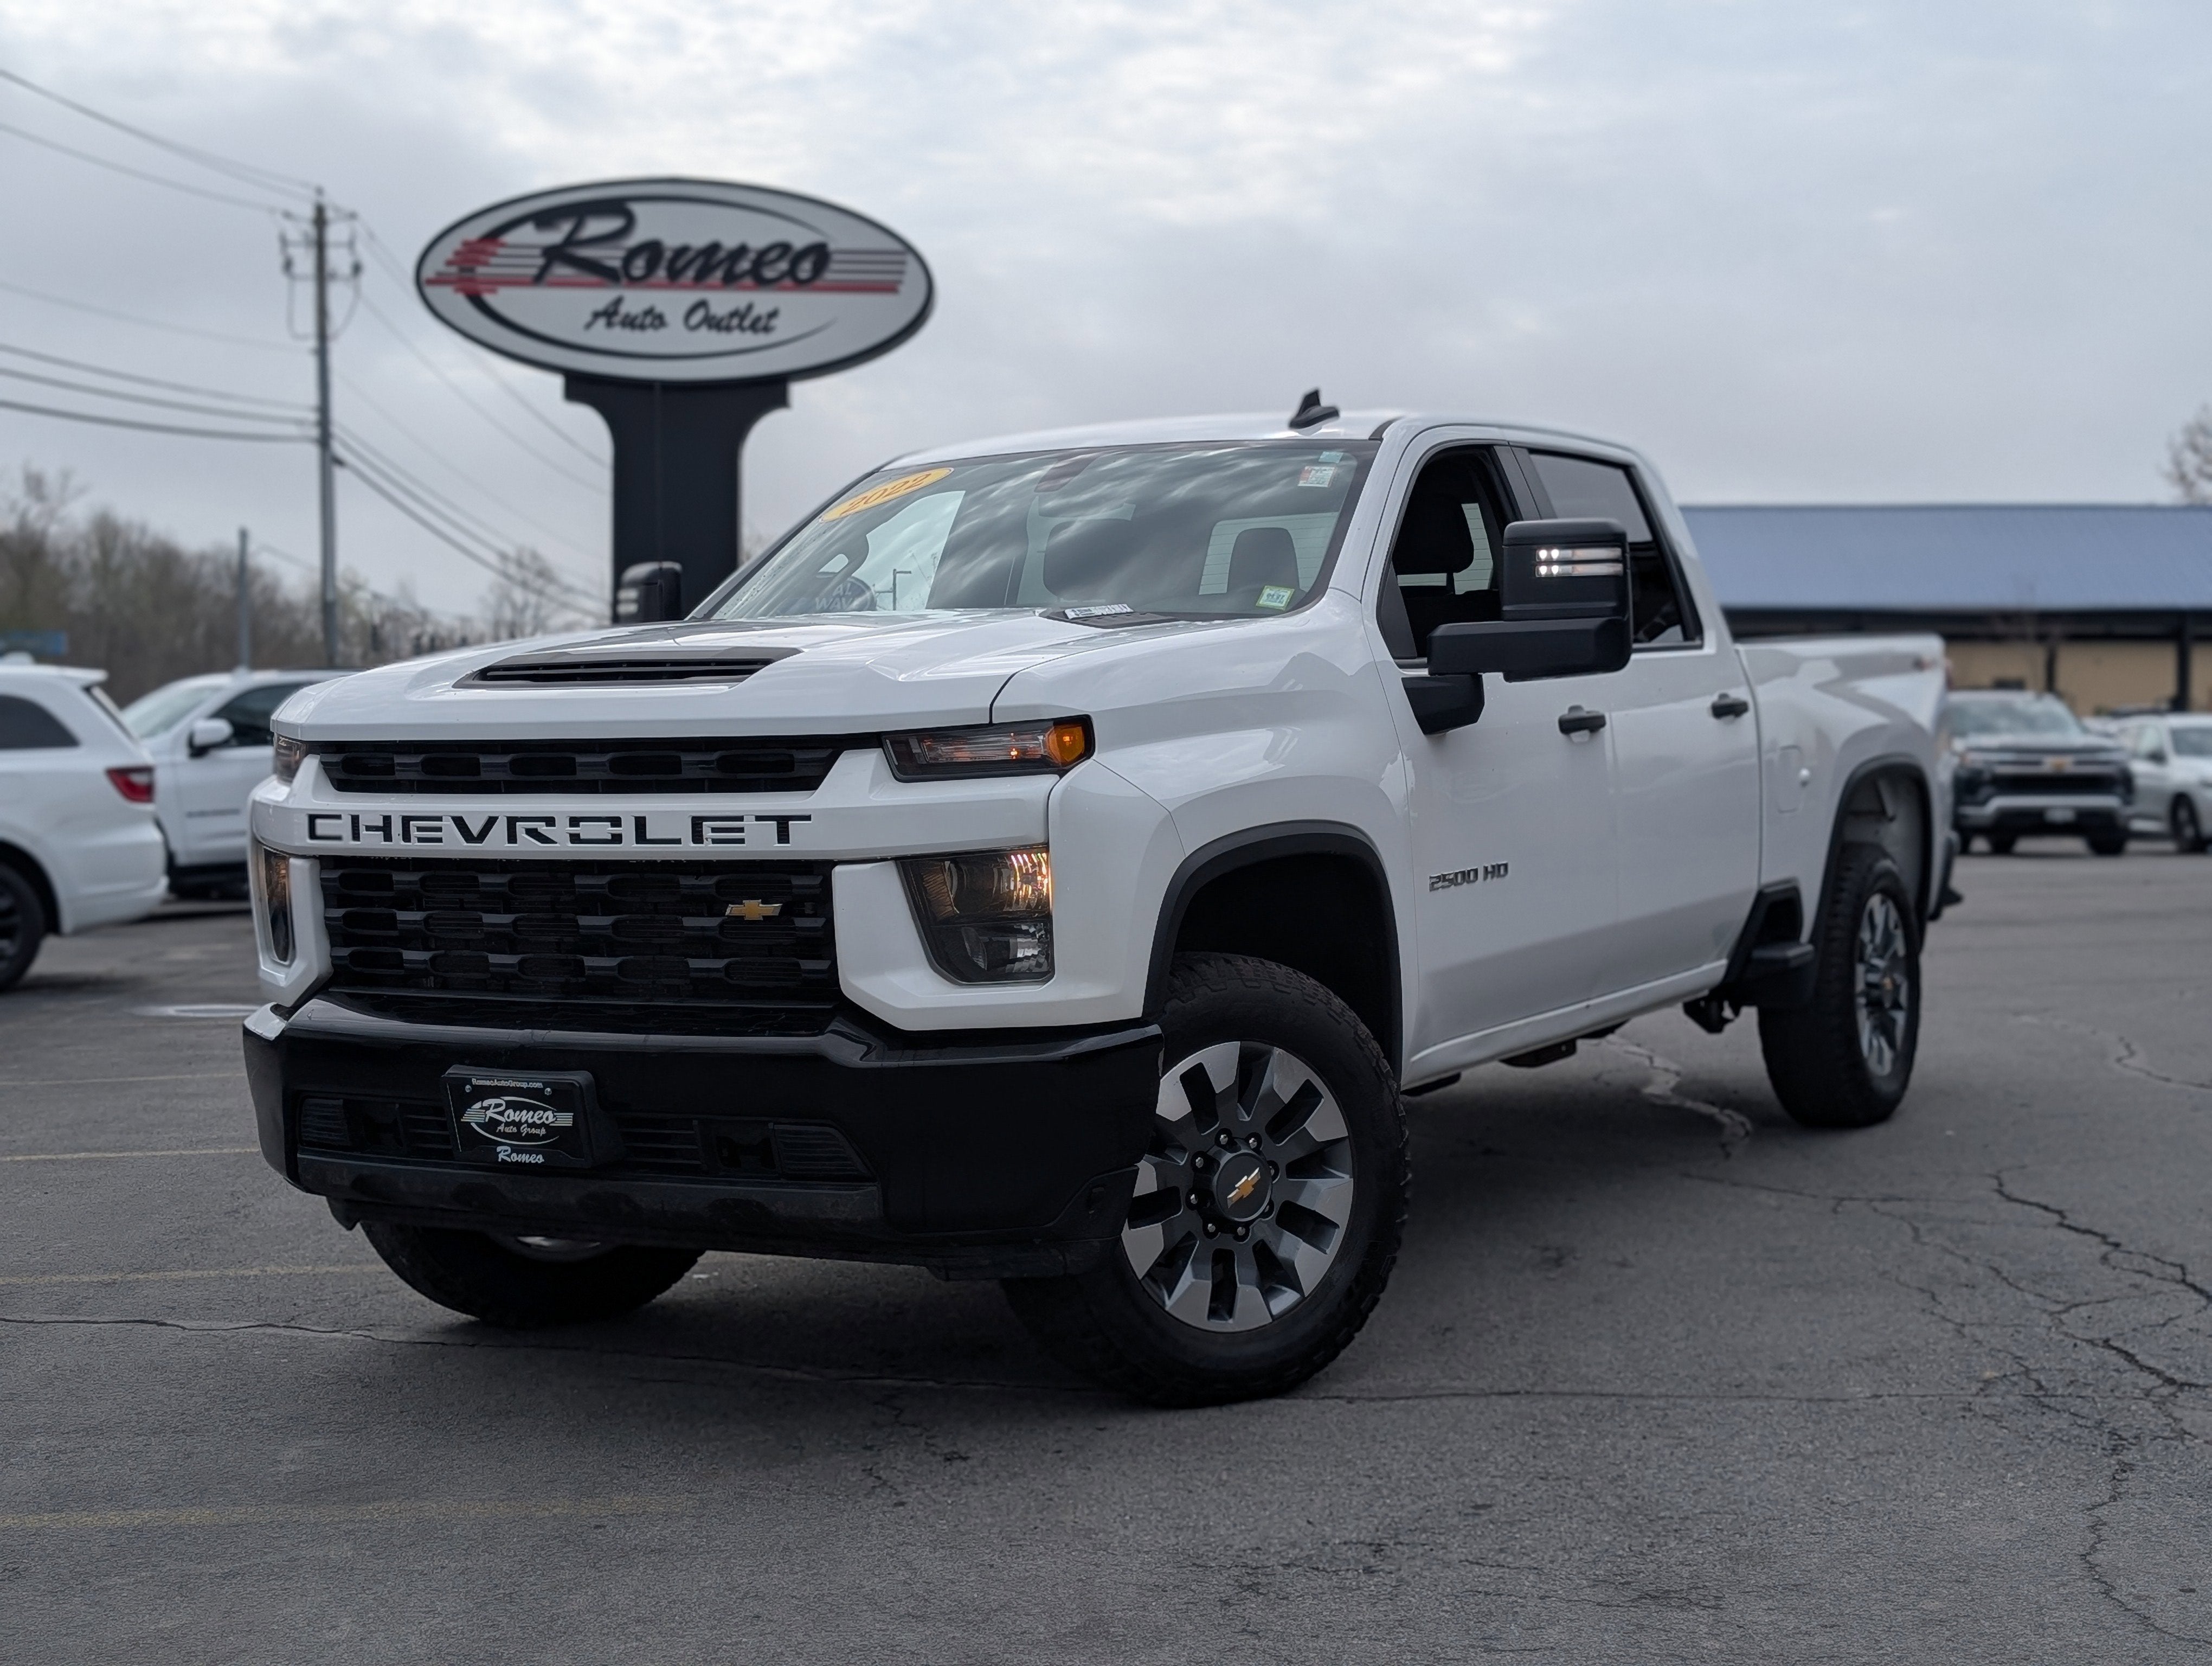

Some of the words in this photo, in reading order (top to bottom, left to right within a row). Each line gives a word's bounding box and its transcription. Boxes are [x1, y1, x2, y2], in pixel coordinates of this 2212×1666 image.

[532, 200, 831, 286] Romeo
[584, 296, 668, 332] Auto
[683, 299, 779, 334] Outlet
[839, 473, 931, 515] 2022
[307, 813, 812, 845] CHEVROLET
[1429, 867, 1478, 892] 2500
[1483, 861, 1508, 882] HD
[482, 1099, 556, 1124] Romeo
[496, 1123, 517, 1133] Auto
[520, 1124, 546, 1137] Group
[497, 1146, 544, 1164] Romeo
